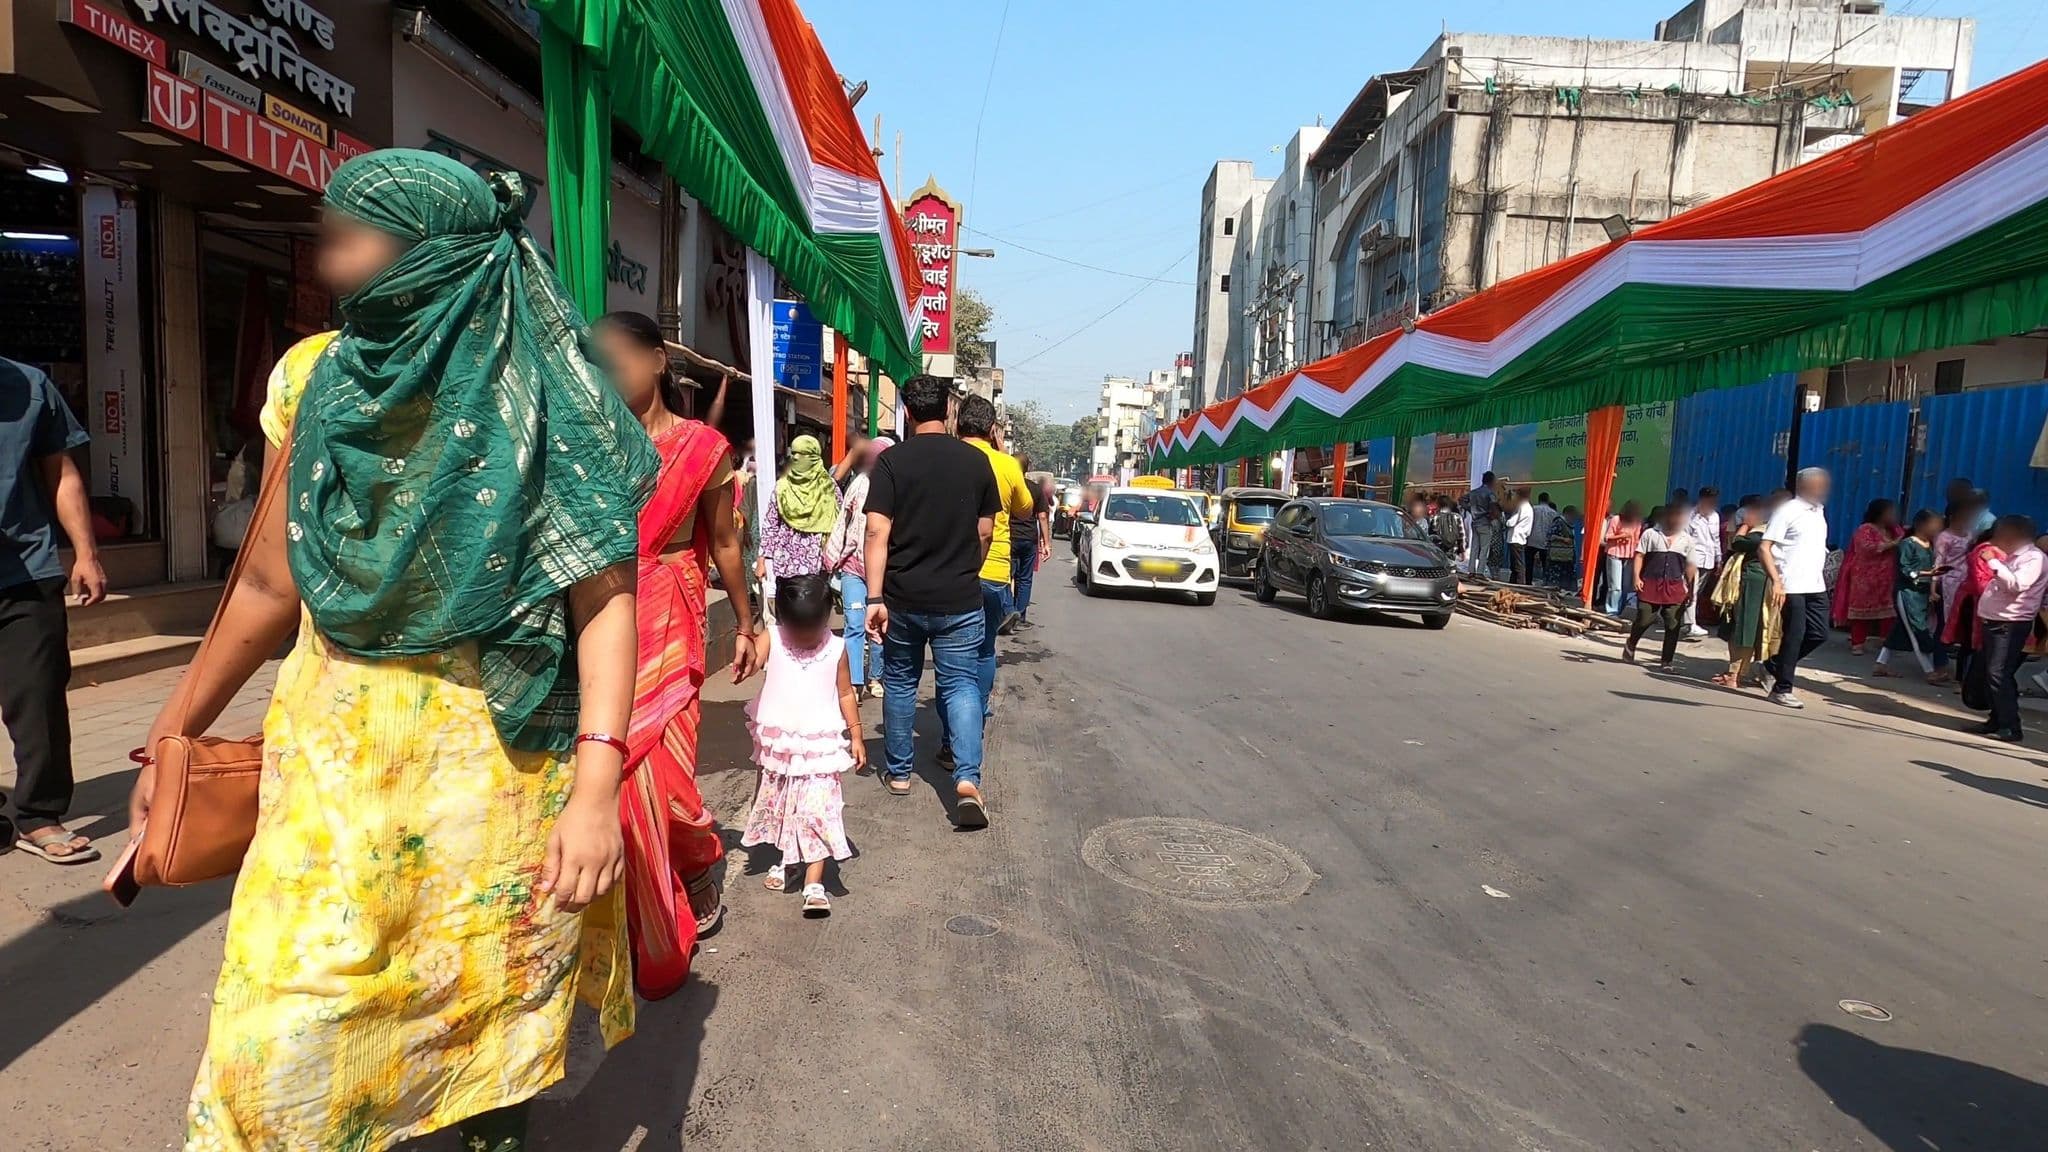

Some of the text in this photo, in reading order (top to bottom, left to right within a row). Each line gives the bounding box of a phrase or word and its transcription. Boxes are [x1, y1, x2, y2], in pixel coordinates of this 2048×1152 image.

[84, 4, 155, 59] TIMEX
[134, 0, 355, 118] इलक्ट्रॉनिक्स
[204, 74, 257, 108] fastrack
[271, 101, 323, 140] SONATA
[208, 95, 345, 189] TITAN
[102, 217, 115, 257] NO.1
[1646, 402, 1667, 419] यांची
